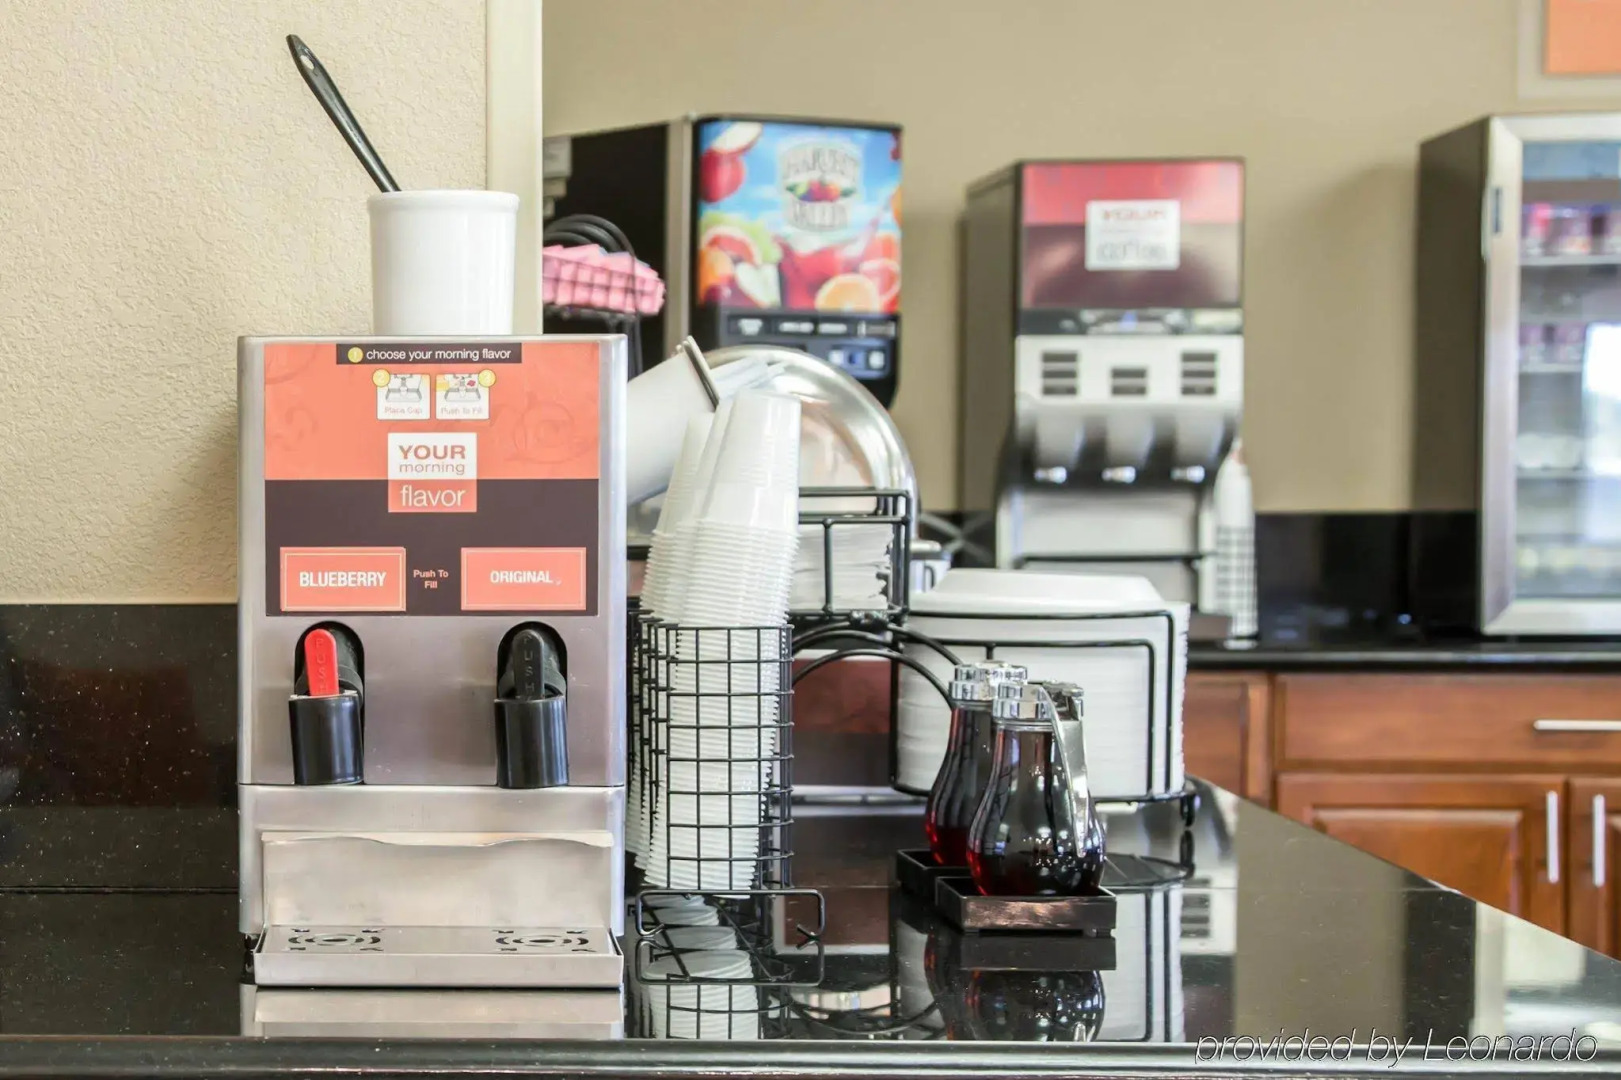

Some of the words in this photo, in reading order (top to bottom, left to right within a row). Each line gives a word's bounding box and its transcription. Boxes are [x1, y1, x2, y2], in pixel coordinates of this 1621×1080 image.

[366, 349, 406, 360] choose
[409, 351, 432, 362] your
[435, 349, 479, 361] morning
[482, 348, 511, 359] flavor
[399, 444, 466, 460] YOUR
[399, 462, 465, 476] morning
[400, 484, 466, 507] flavor
[299, 570, 387, 588] BLUEBERRY
[413, 569, 435, 579] Push
[437, 569, 449, 579] To
[490, 570, 553, 584] ORIGINAL
[424, 580, 438, 590] Fill
[314, 637, 328, 693] PUSH
[522, 635, 536, 691] PUSH
